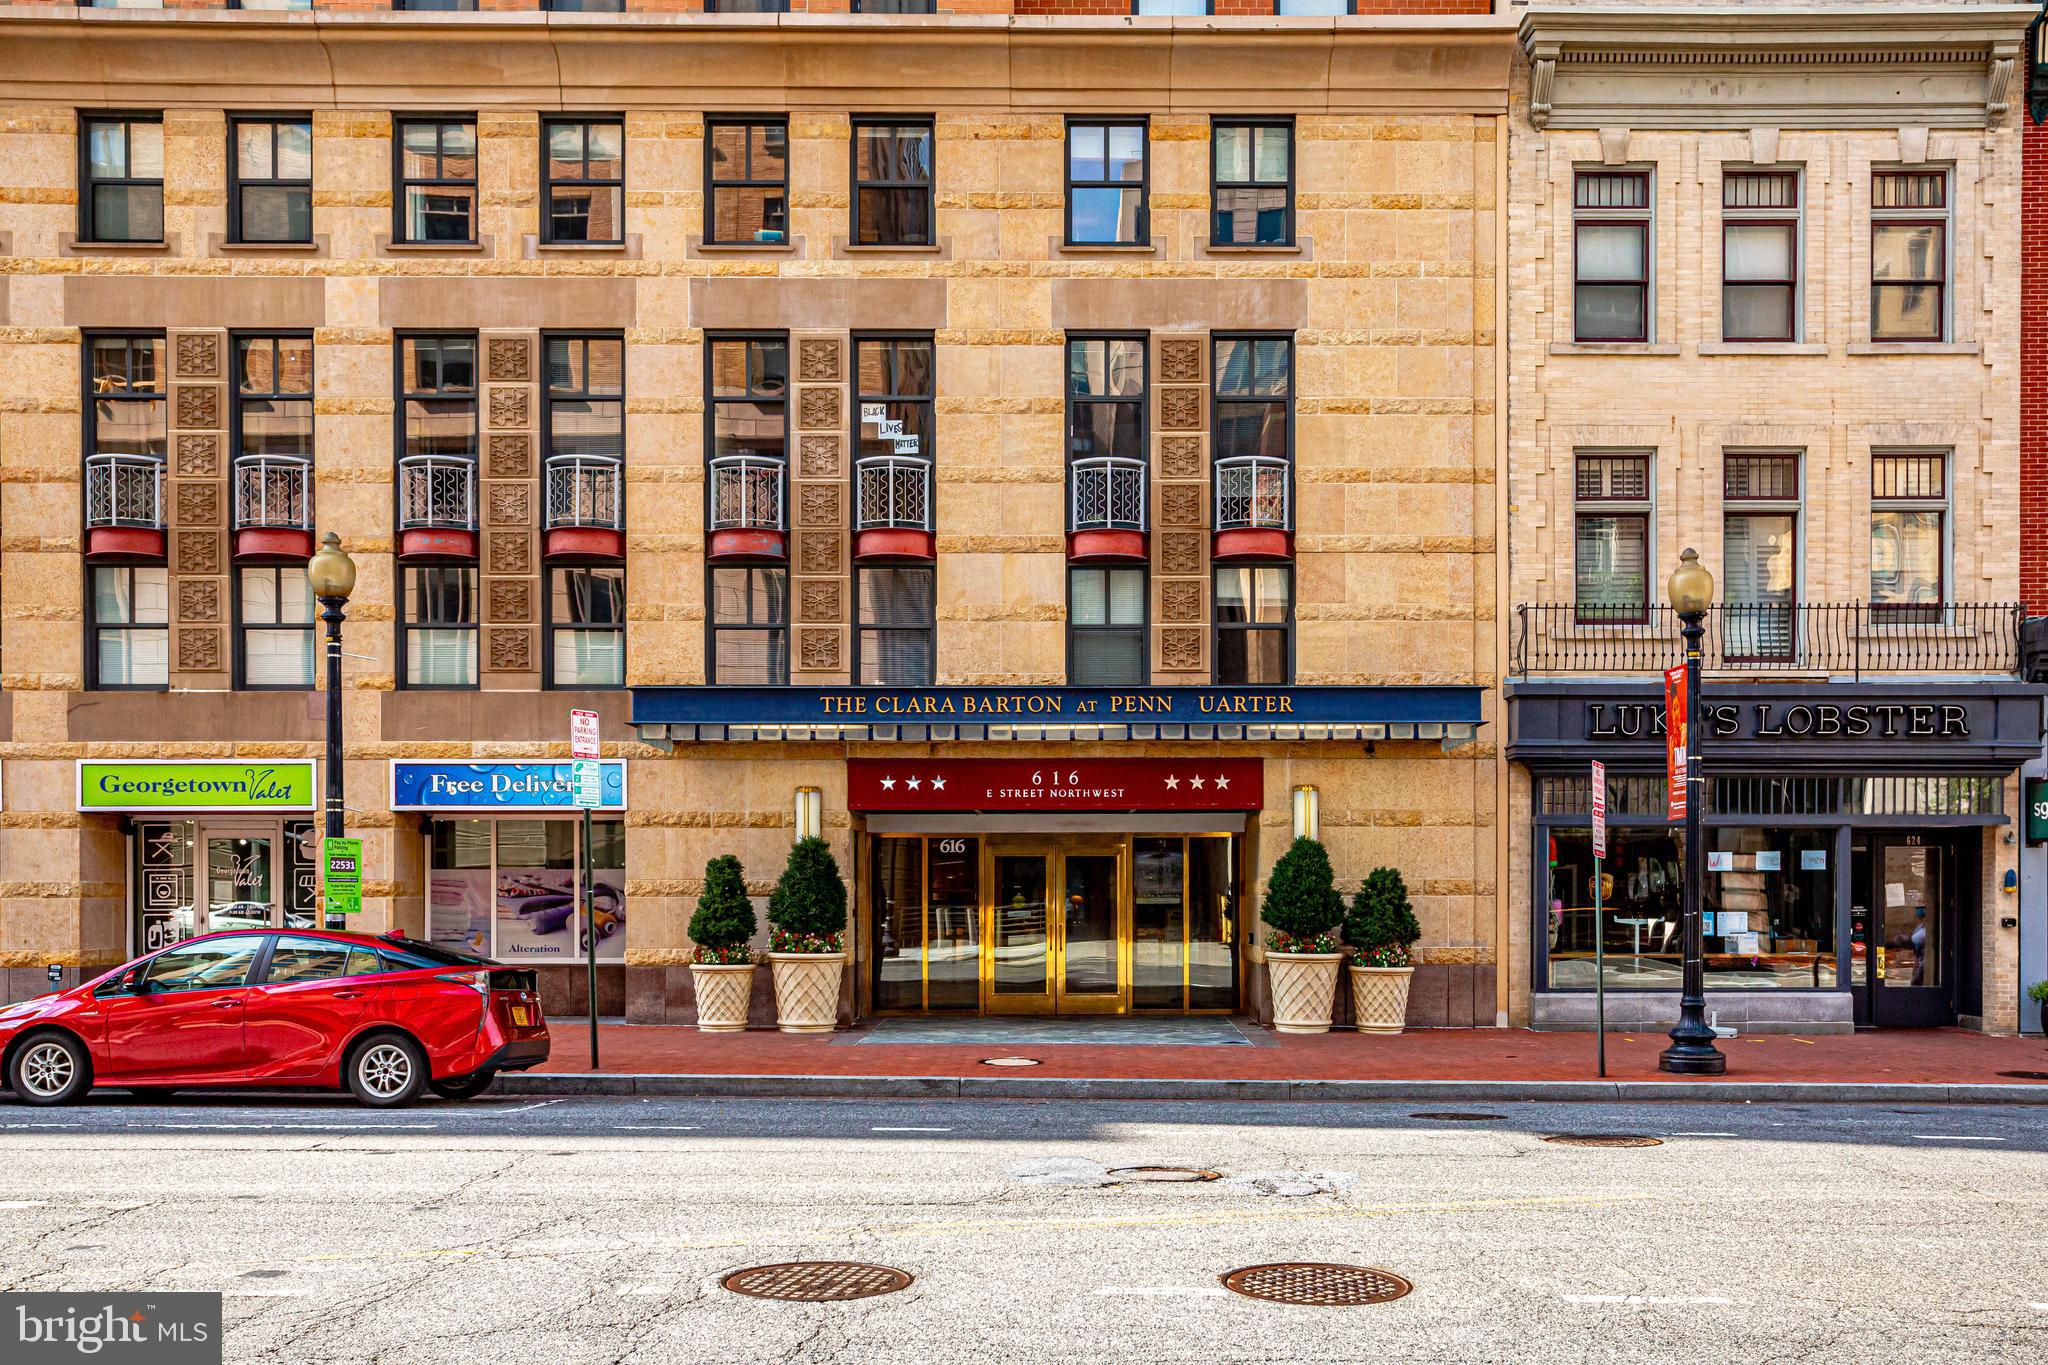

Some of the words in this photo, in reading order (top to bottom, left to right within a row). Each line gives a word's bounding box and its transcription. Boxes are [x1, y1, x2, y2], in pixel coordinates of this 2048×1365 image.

[863, 406, 885, 417] BLACK
[880, 422, 903, 434] LIVES
[895, 438, 919, 449] MATTER
[820, 696, 867, 713] THE
[875, 696, 956, 713] CLARA
[963, 696, 1062, 713] BARTON
[1076, 701, 1098, 712] AT
[1110, 696, 1173, 712] PENN
[1198, 696, 1295, 712] UARTER
[579, 718, 590, 726] NO
[1591, 705, 1739, 735] LUK'S
[1757, 705, 1969, 735] LOBSTER
[574, 727, 597, 735] PARKING
[574, 736, 597, 744] ENTRANCE
[99, 775, 248, 797] Georgetown
[245, 769, 292, 800] Valet
[430, 774, 484, 793] Free
[490, 773, 575, 793] Deliver
[986, 789, 992, 798] E
[1000, 789, 1044, 798] STREET
[1050, 789, 1125, 798] NORTHWEST
[939, 838, 966, 853] 616
[1906, 835, 1921, 845] 624
[230, 854, 263, 887] Valet
[330, 860, 355, 870] 22531
[508, 944, 560, 952] Alteration
